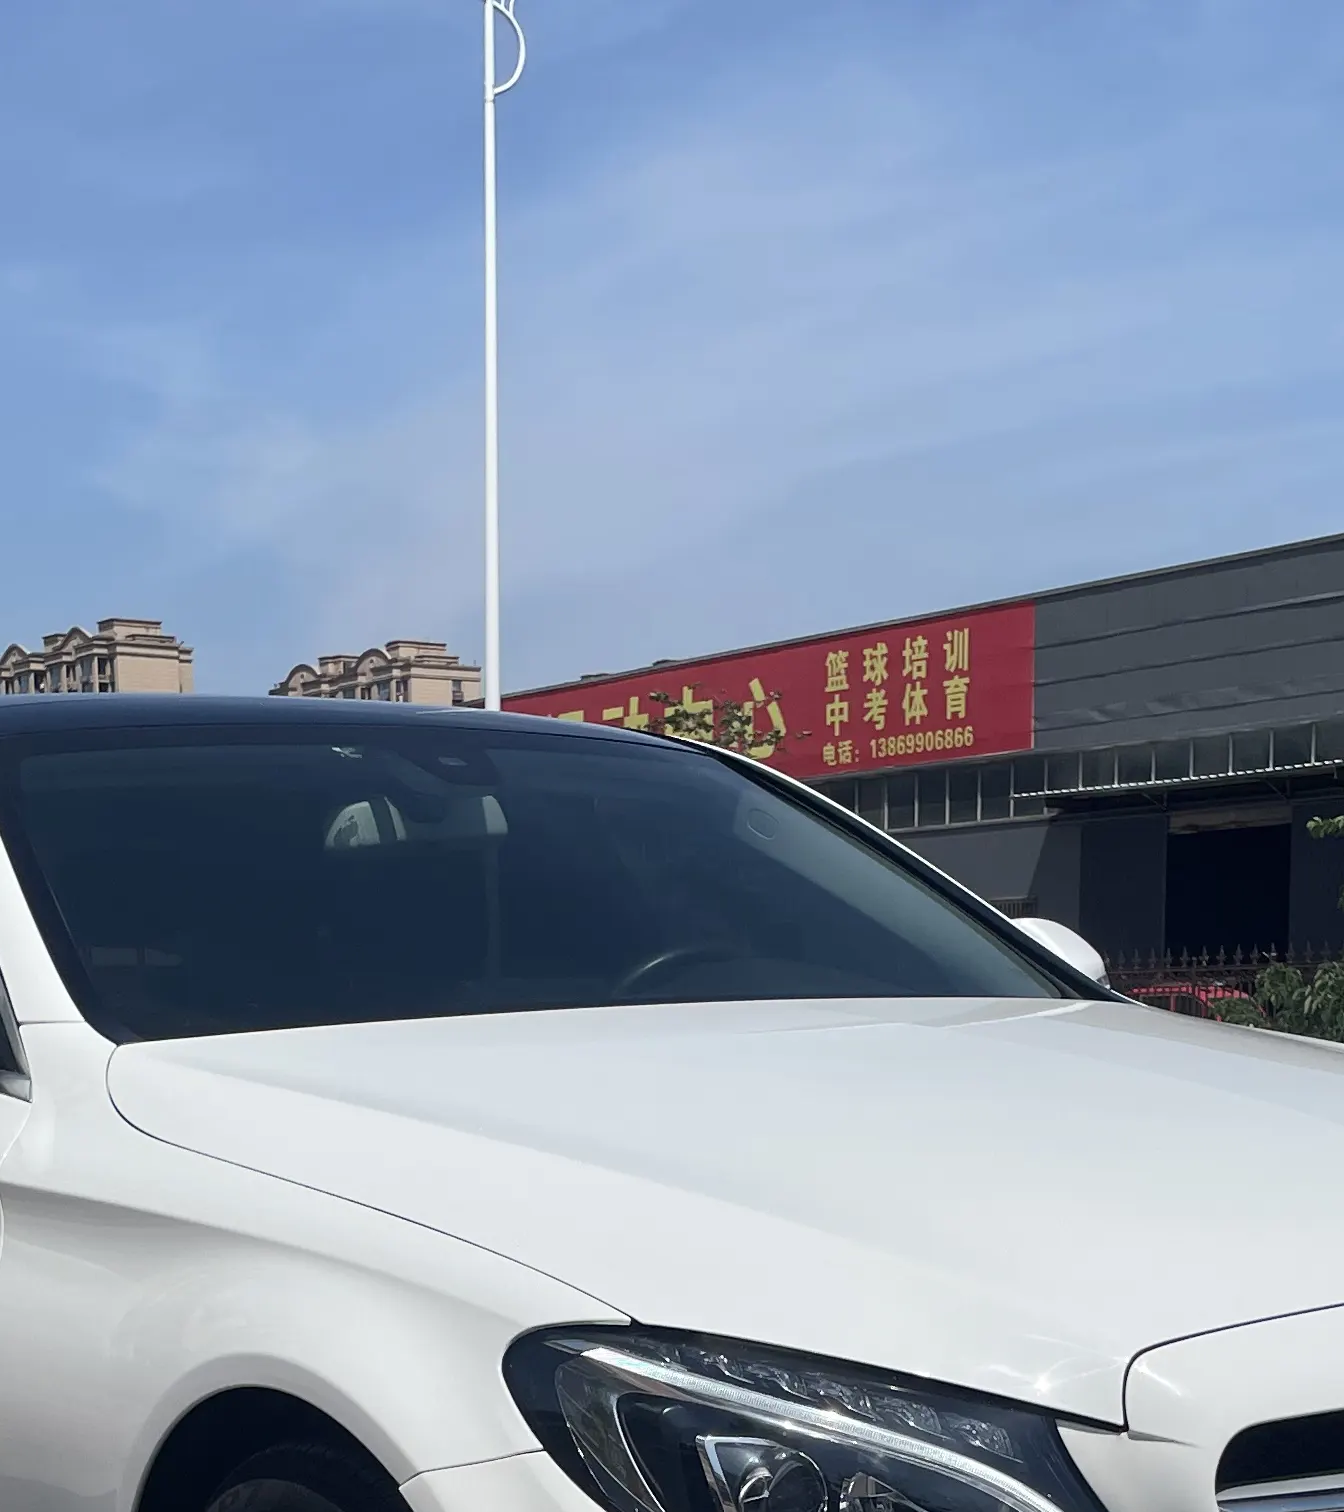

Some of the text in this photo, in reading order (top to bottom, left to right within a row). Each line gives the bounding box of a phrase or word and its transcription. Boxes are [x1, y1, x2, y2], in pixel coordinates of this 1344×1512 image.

[824, 627, 970, 693] 篮球培训
[824, 674, 970, 737] 中考体育
[869, 725, 974, 759] 13869906866
